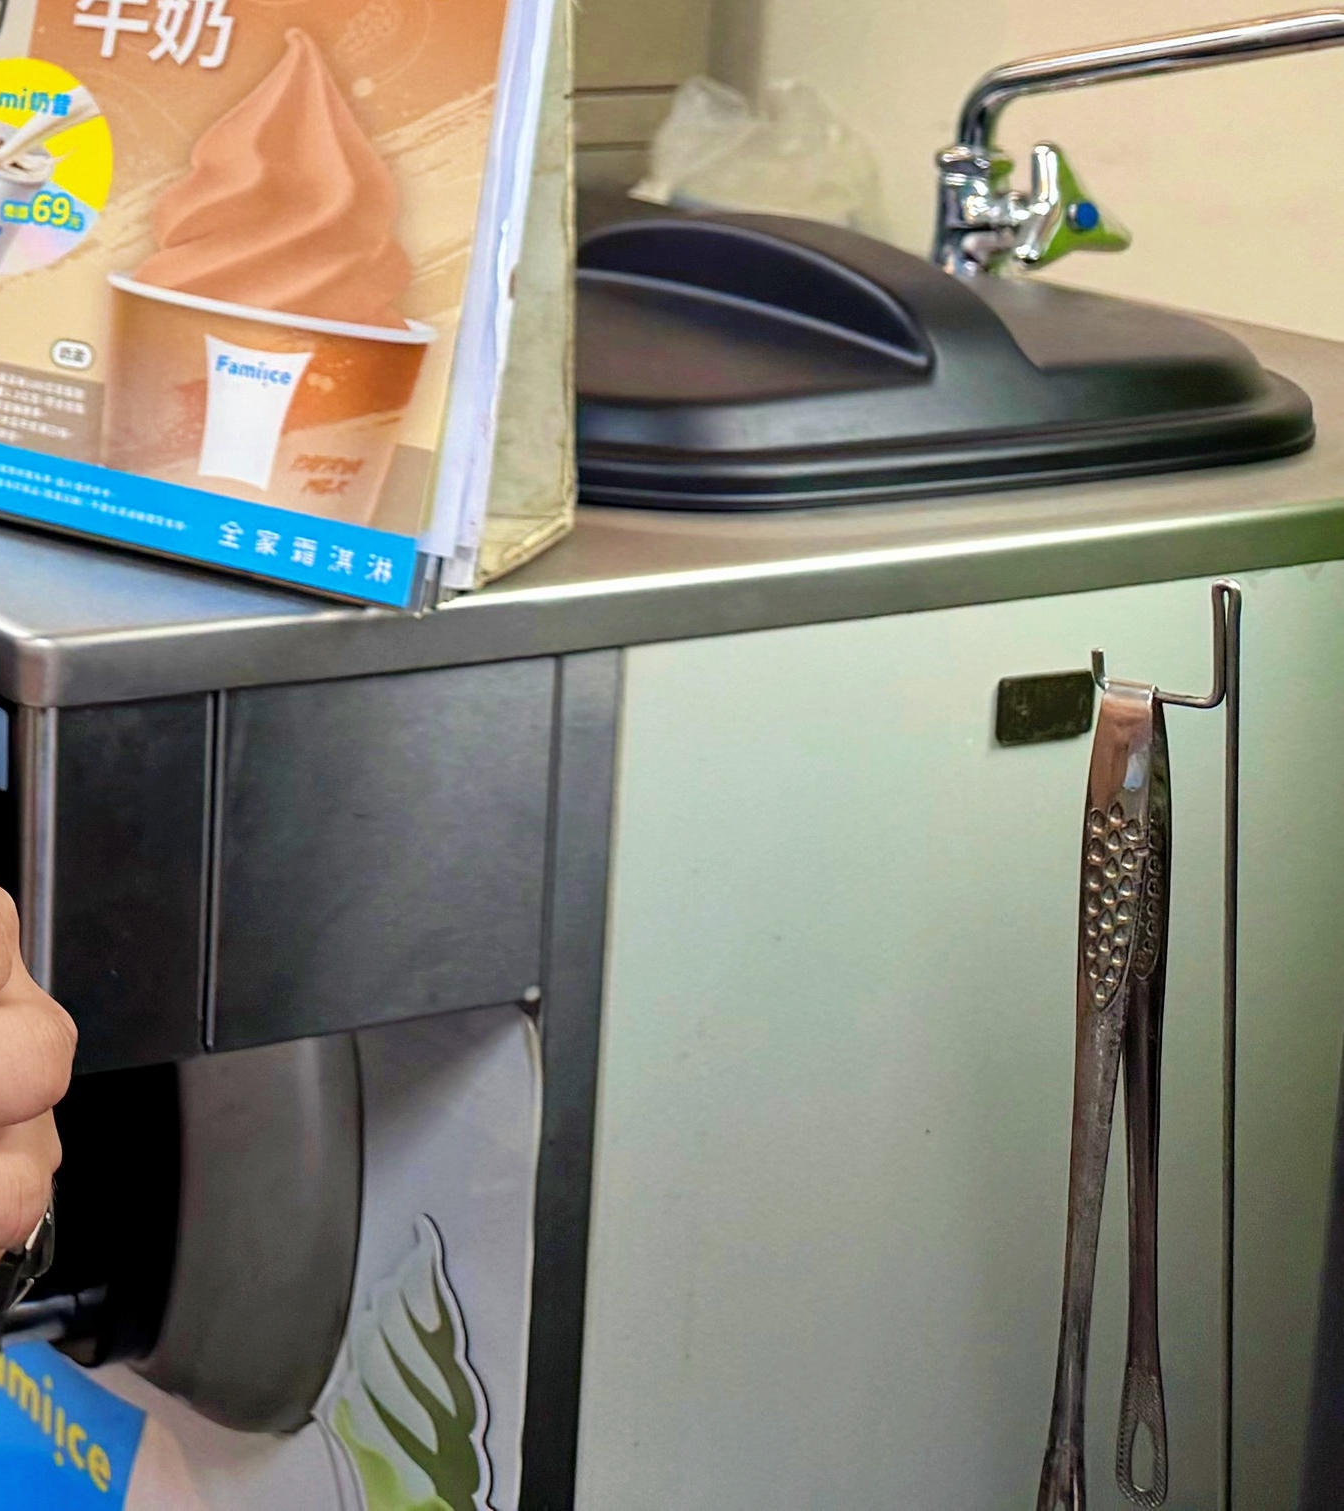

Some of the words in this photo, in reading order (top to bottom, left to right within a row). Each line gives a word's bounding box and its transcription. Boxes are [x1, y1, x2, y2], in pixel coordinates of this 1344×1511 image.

[218, 521, 393, 584] 全家霜淇淋
